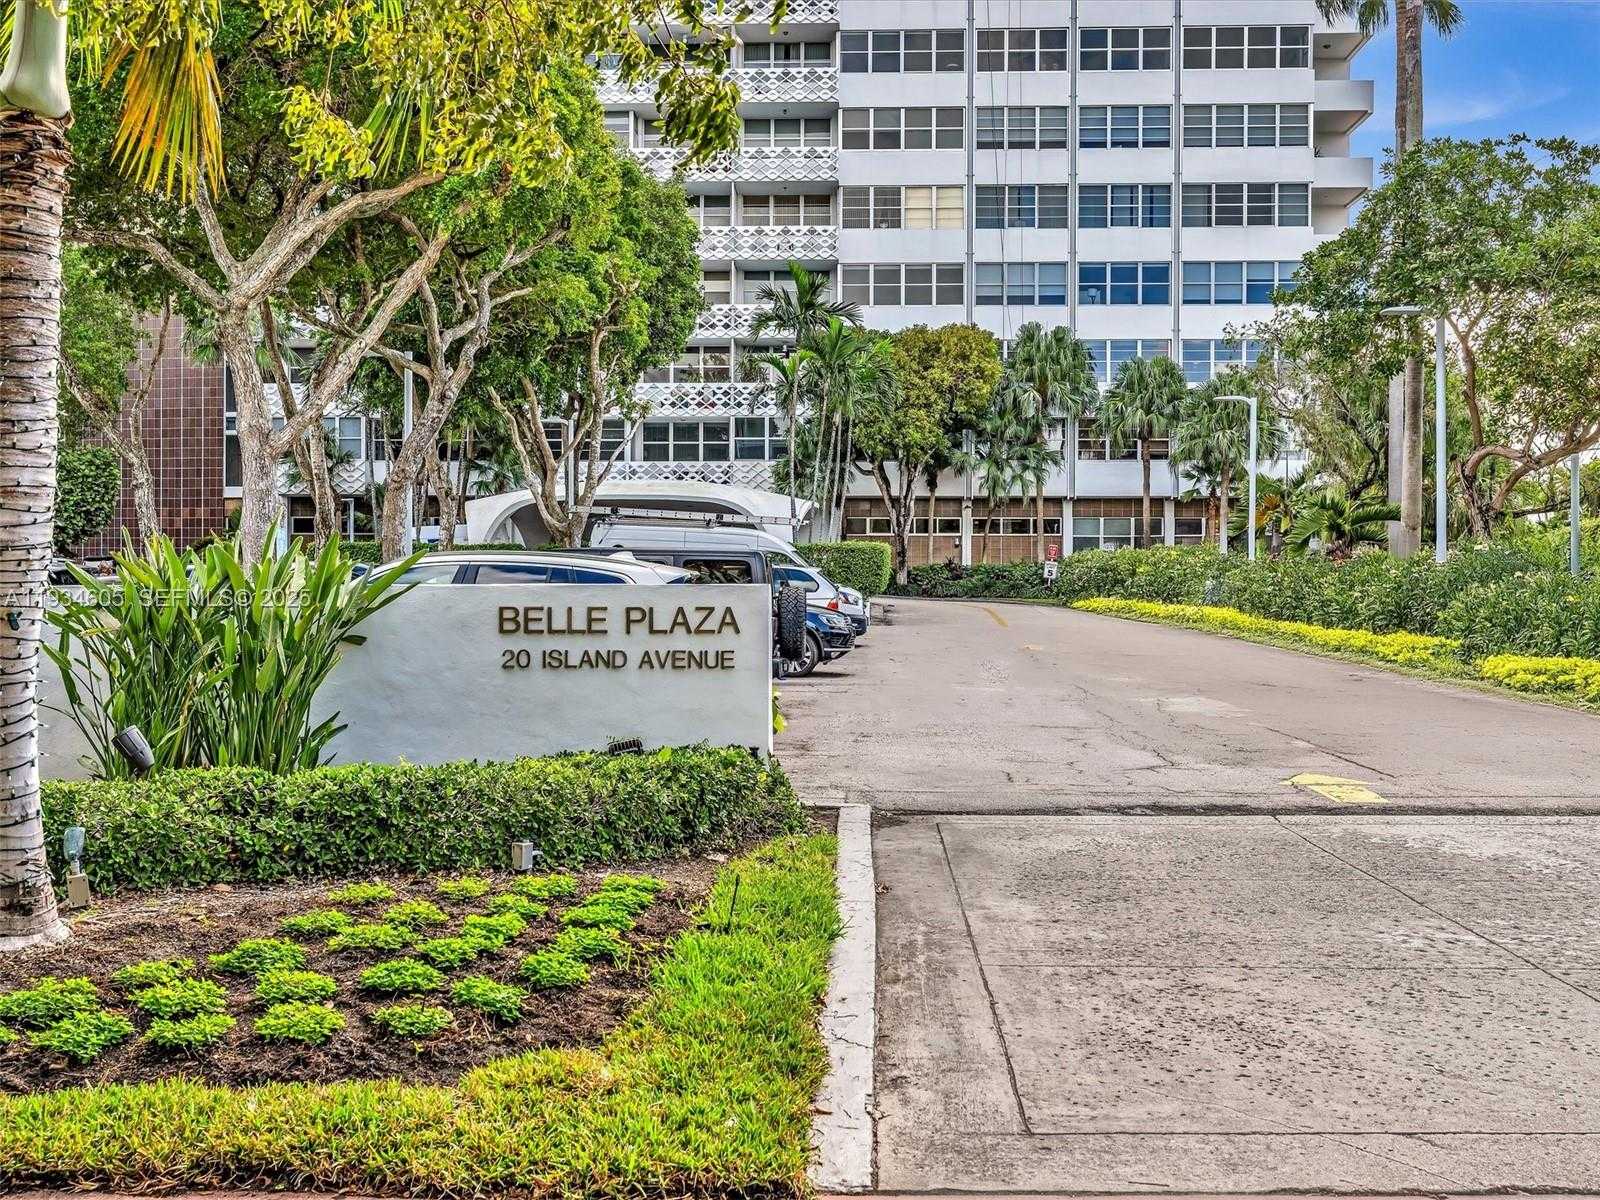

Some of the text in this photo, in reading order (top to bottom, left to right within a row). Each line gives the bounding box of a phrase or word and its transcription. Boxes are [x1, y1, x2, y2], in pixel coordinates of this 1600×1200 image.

[1047, 569, 1053, 577] 5
[498, 606, 741, 635] BELLE PLAZA
[501, 649, 736, 670] 20 ISLAND AVENUE
